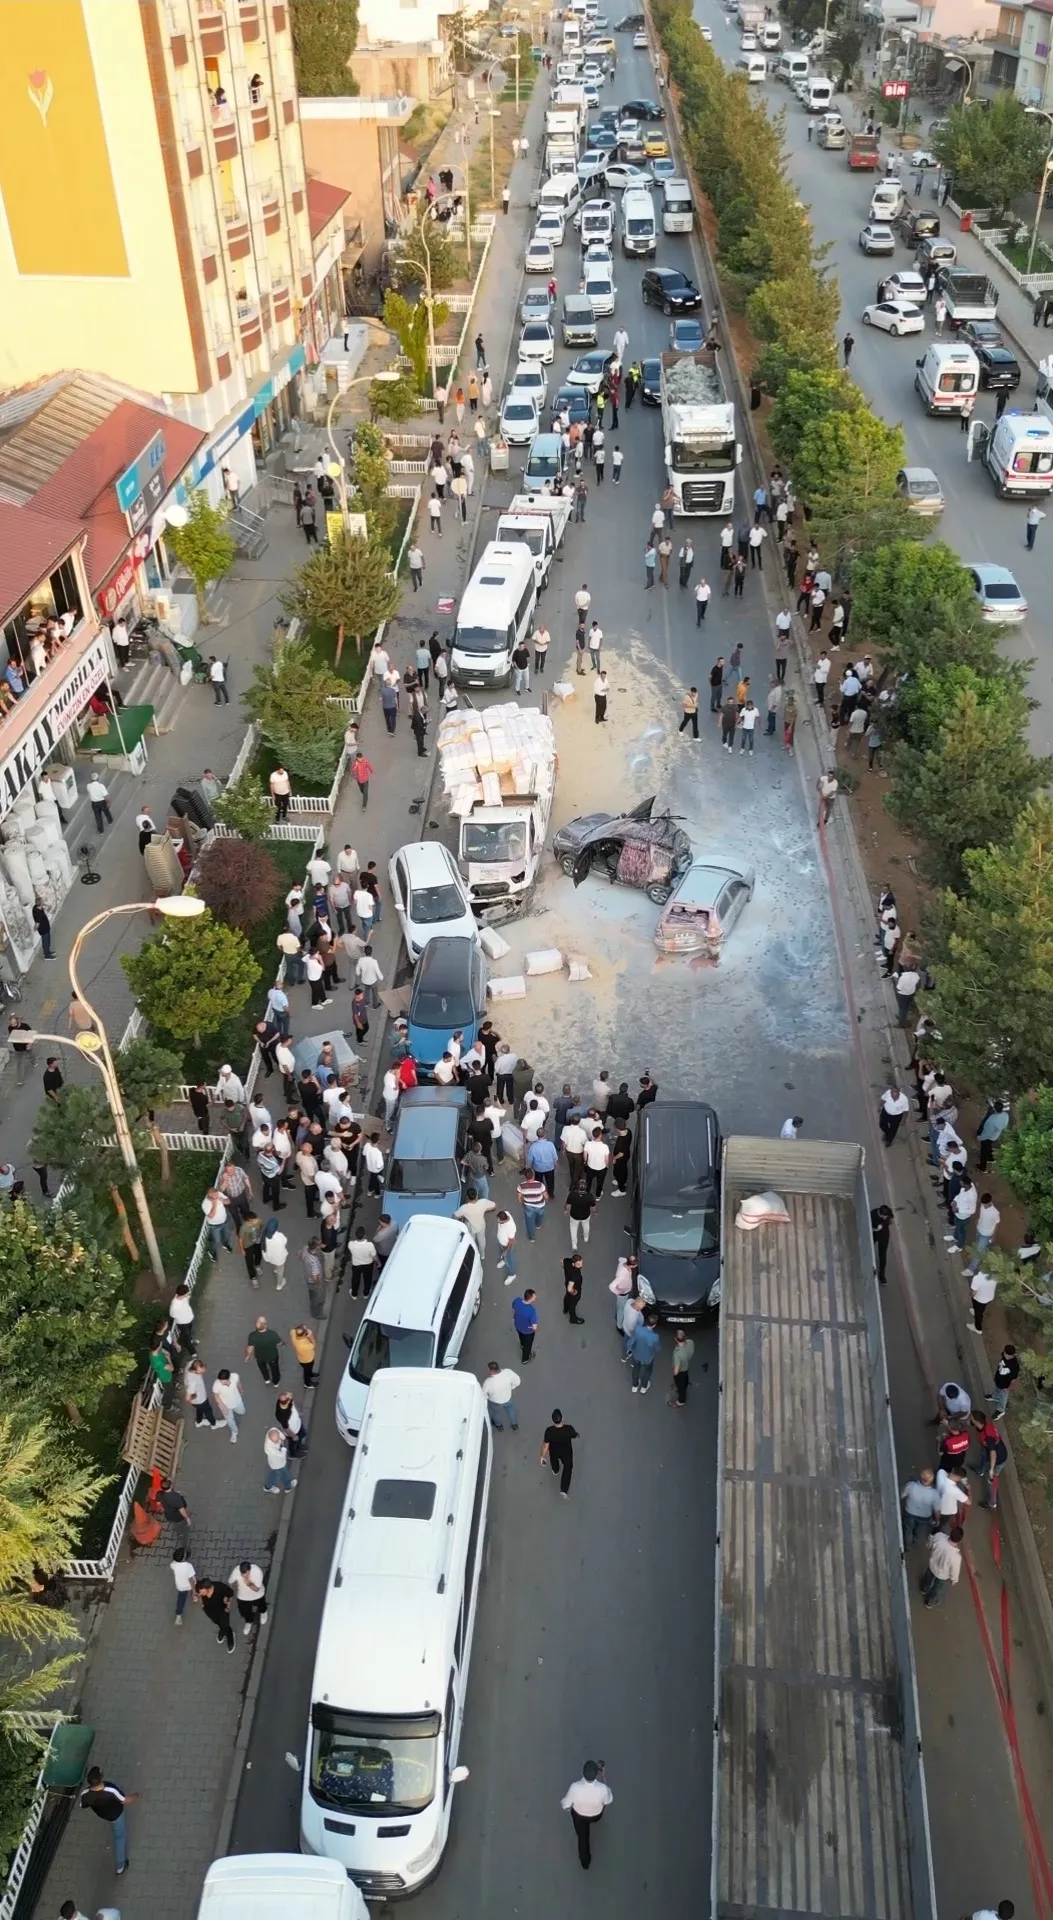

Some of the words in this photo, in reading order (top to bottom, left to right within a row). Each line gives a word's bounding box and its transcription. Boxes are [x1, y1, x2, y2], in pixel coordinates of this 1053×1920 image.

[885, 83, 906, 96] BİM
[54, 647, 103, 719] MOBİLYA
[0, 708, 55, 816] AKAY
